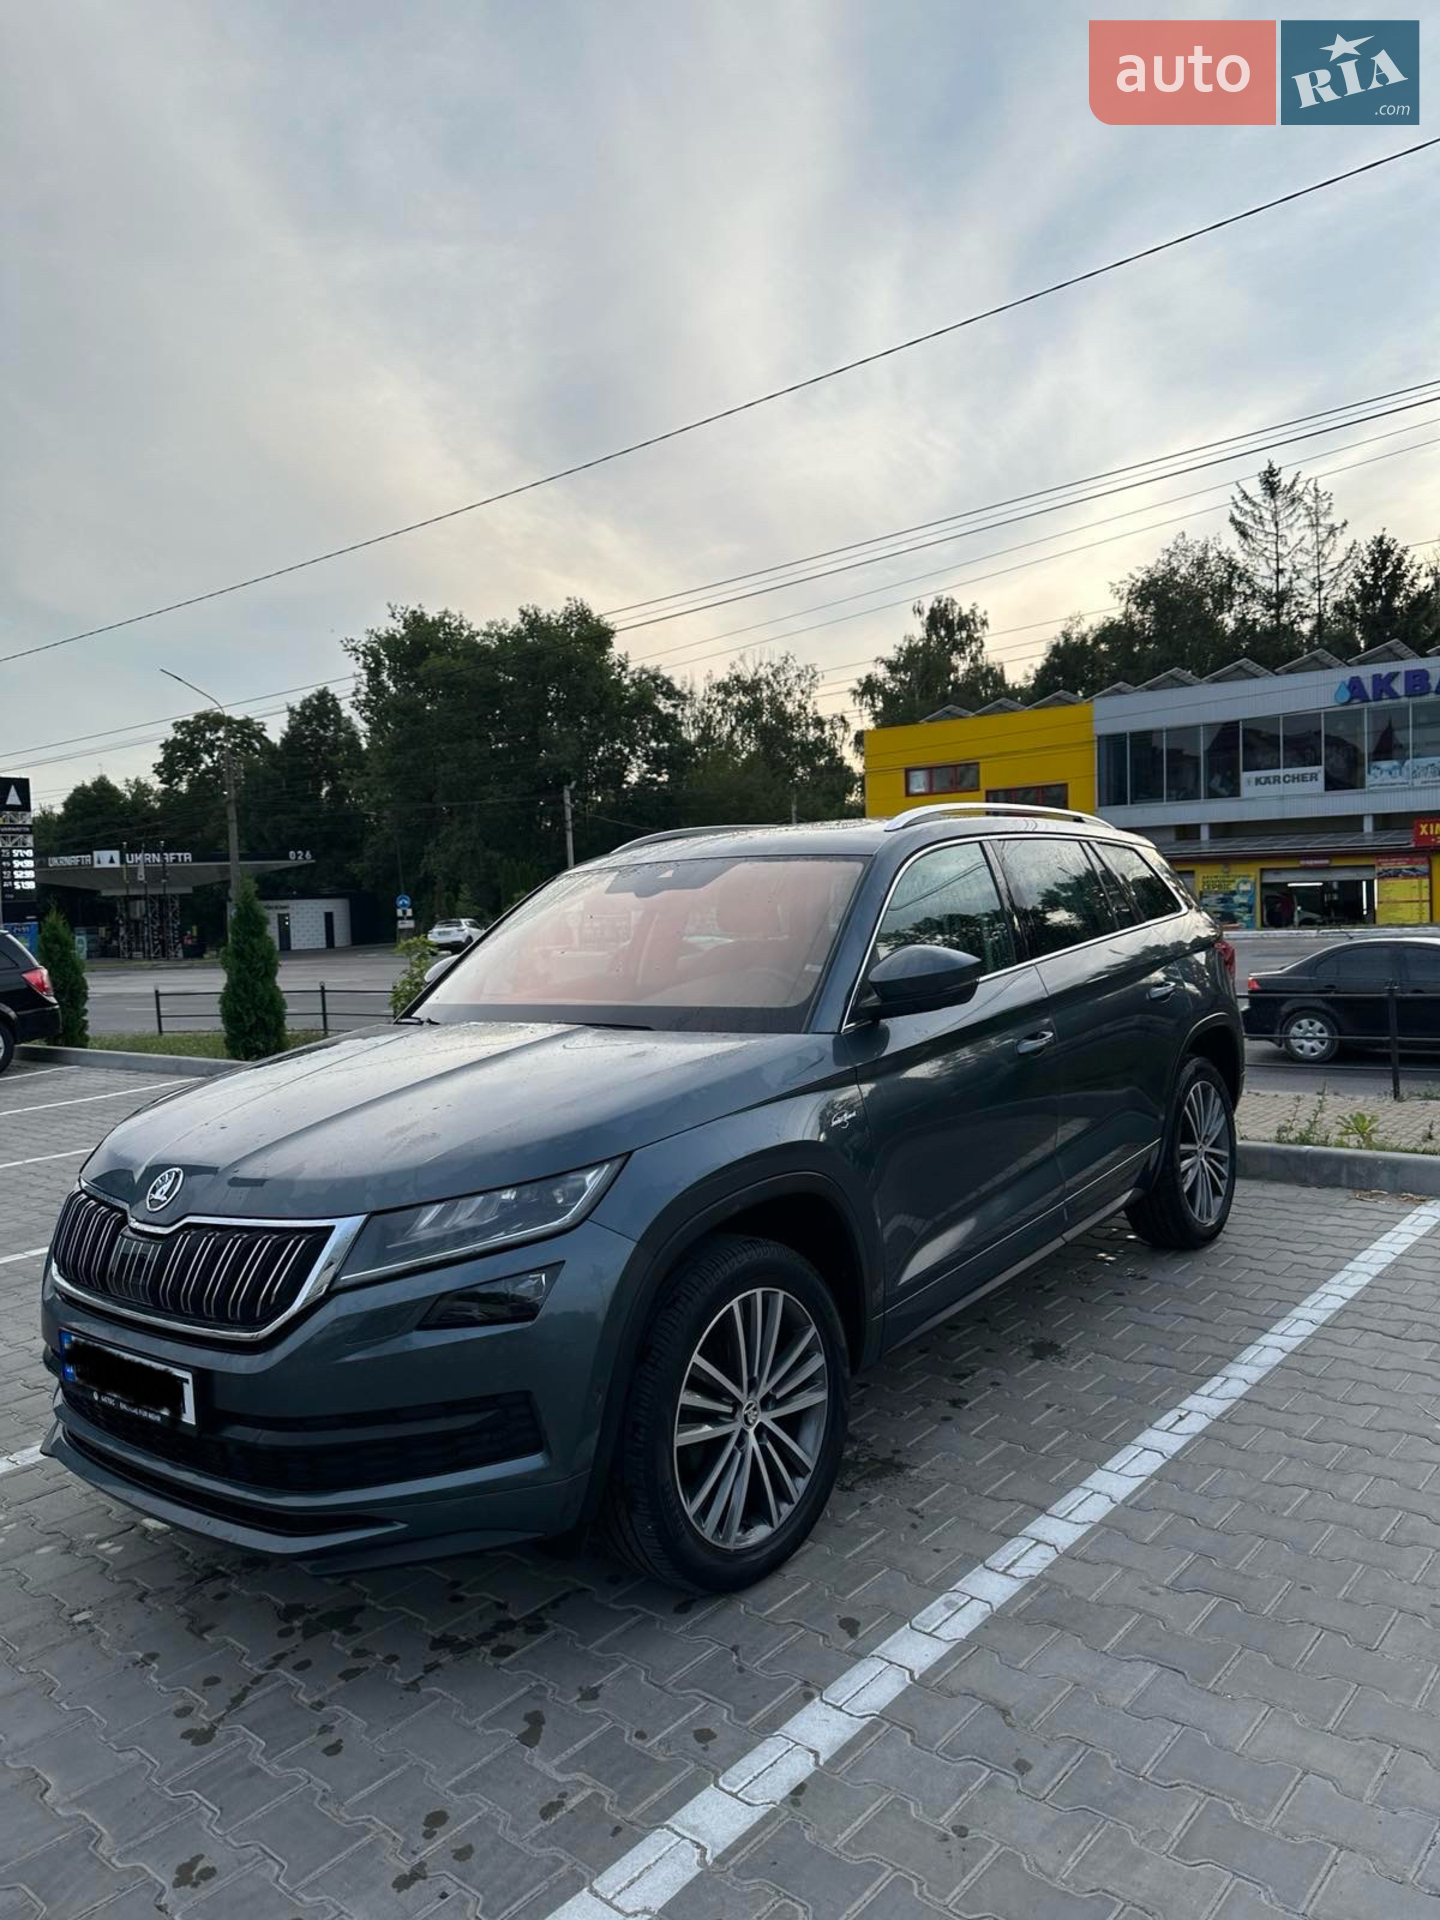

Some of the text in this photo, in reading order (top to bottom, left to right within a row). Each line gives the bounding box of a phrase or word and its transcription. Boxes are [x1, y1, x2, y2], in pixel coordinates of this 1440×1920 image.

[1348, 668, 1440, 702] АКВ
[48, 855, 92, 867] UKRNAFTA
[126, 852, 192, 864] UKRNAFTA
[288, 850, 312, 861] 026
